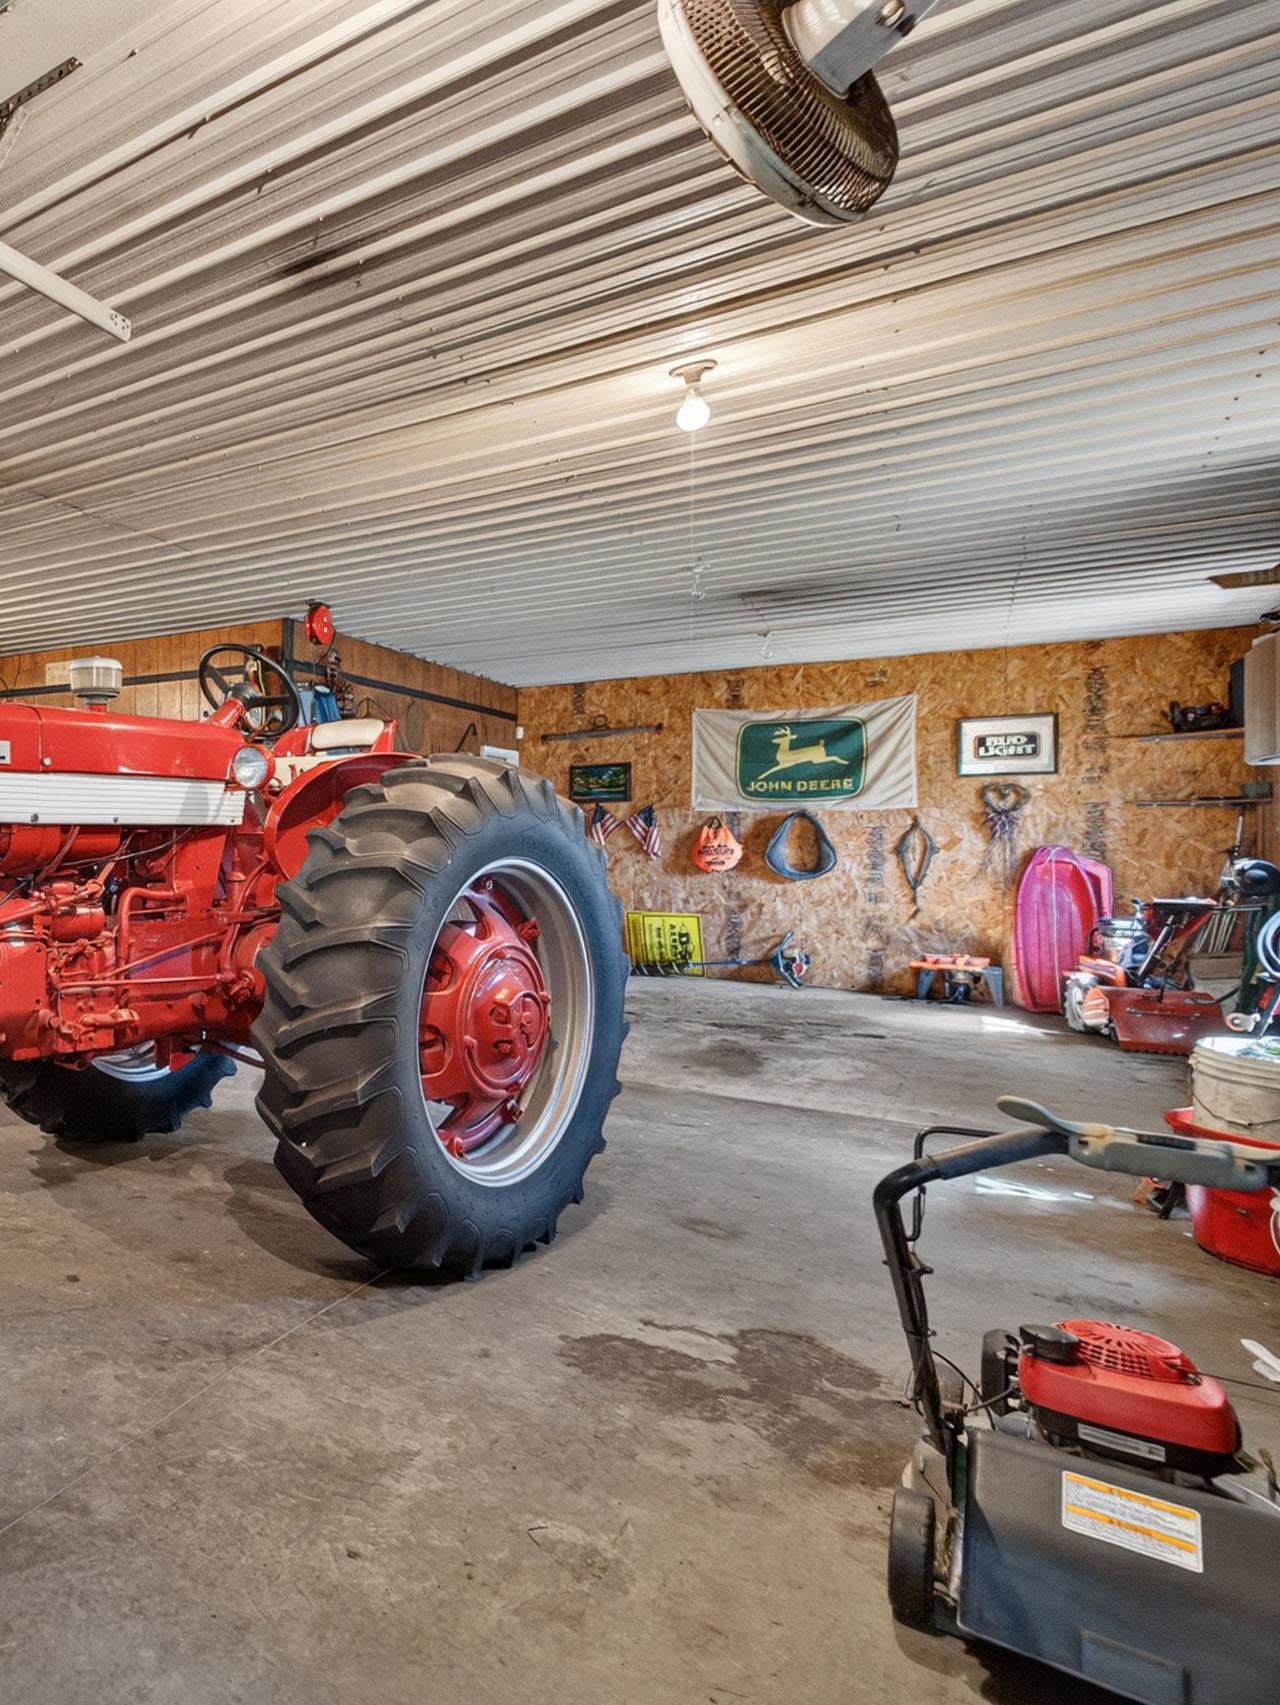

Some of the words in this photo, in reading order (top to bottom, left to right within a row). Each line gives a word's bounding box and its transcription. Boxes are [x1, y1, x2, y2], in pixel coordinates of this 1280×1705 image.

[986, 735, 1028, 746] BUD
[979, 744, 1036, 757] LIGHT
[747, 780, 793, 792] JOHN
[796, 778, 854, 792] DEERE
